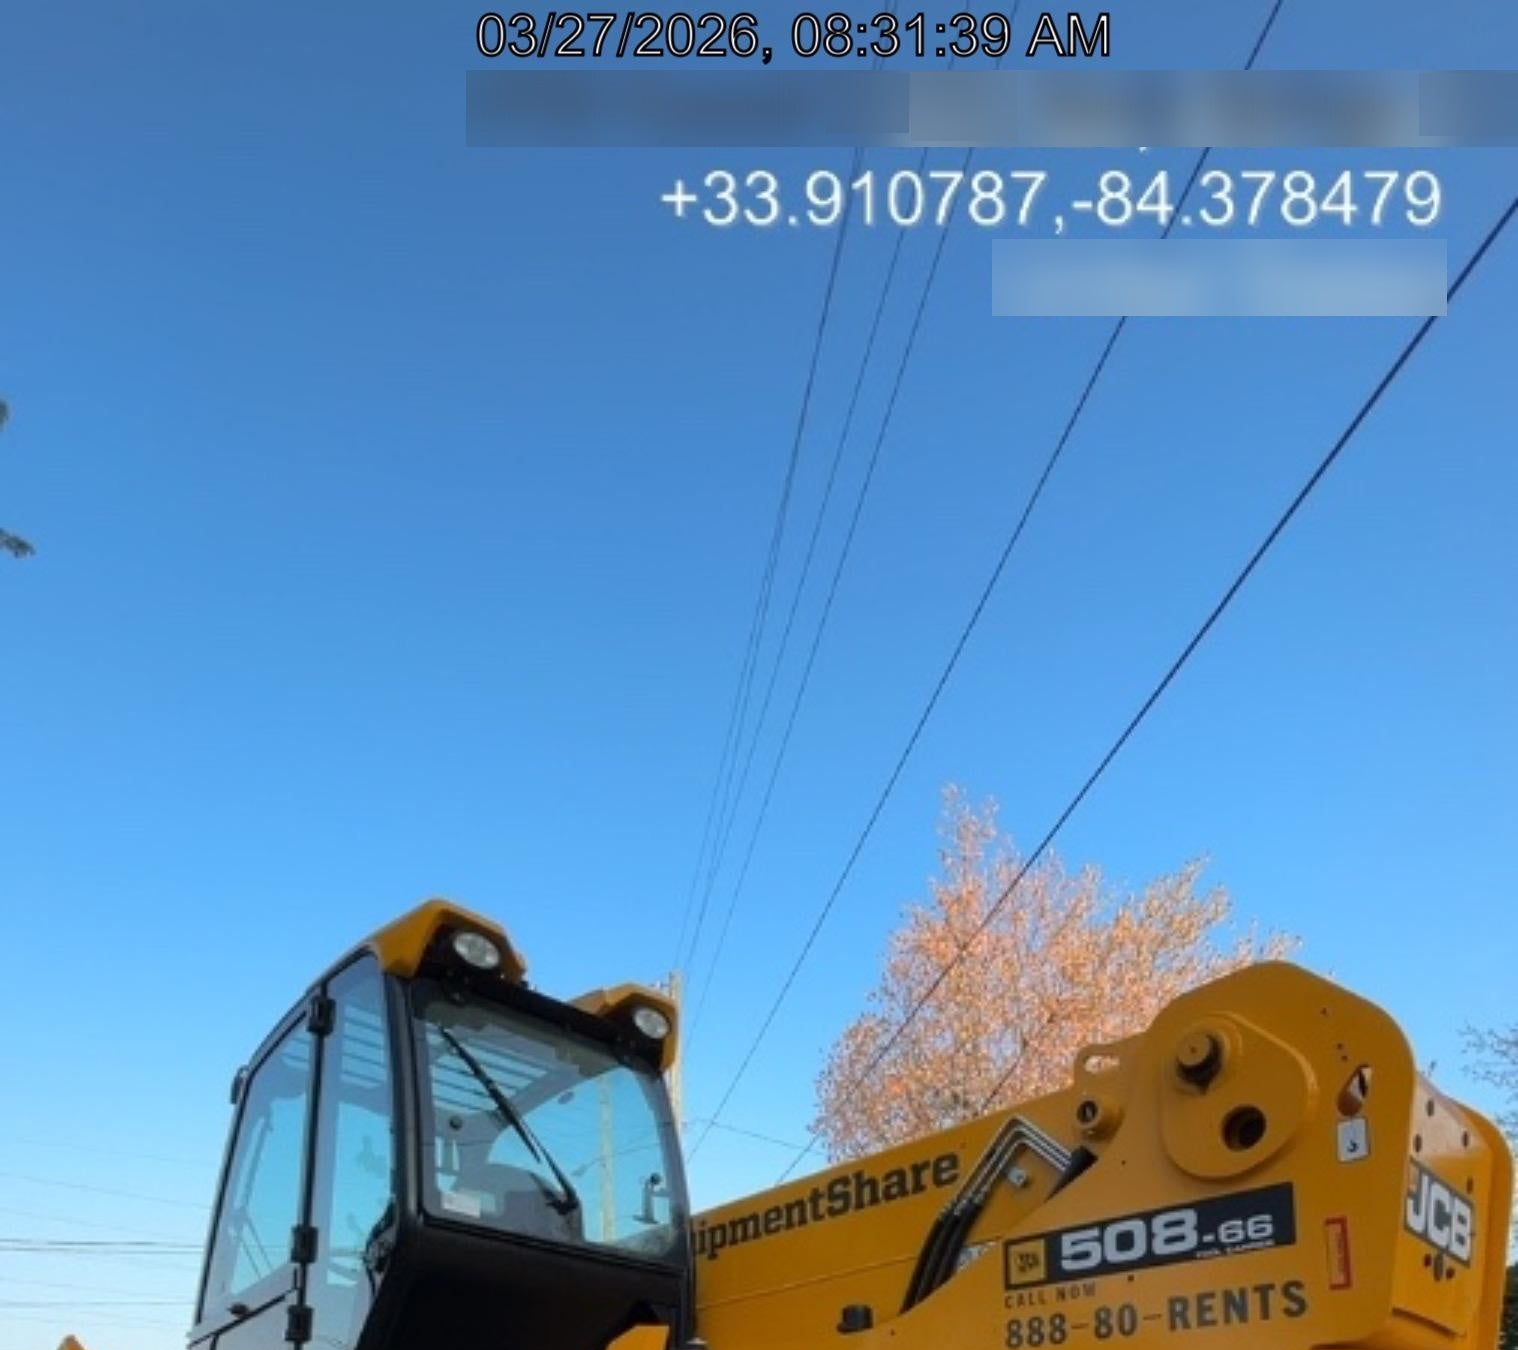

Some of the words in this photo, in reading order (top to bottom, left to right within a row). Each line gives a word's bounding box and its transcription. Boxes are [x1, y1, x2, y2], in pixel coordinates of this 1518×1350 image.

[1406, 1172, 1471, 1262] JCB
[1004, 1290, 1046, 1309] CALL
[1056, 1282, 1096, 1302] NOW
[1005, 1280, 1309, 1349] 888-80-RENTS
